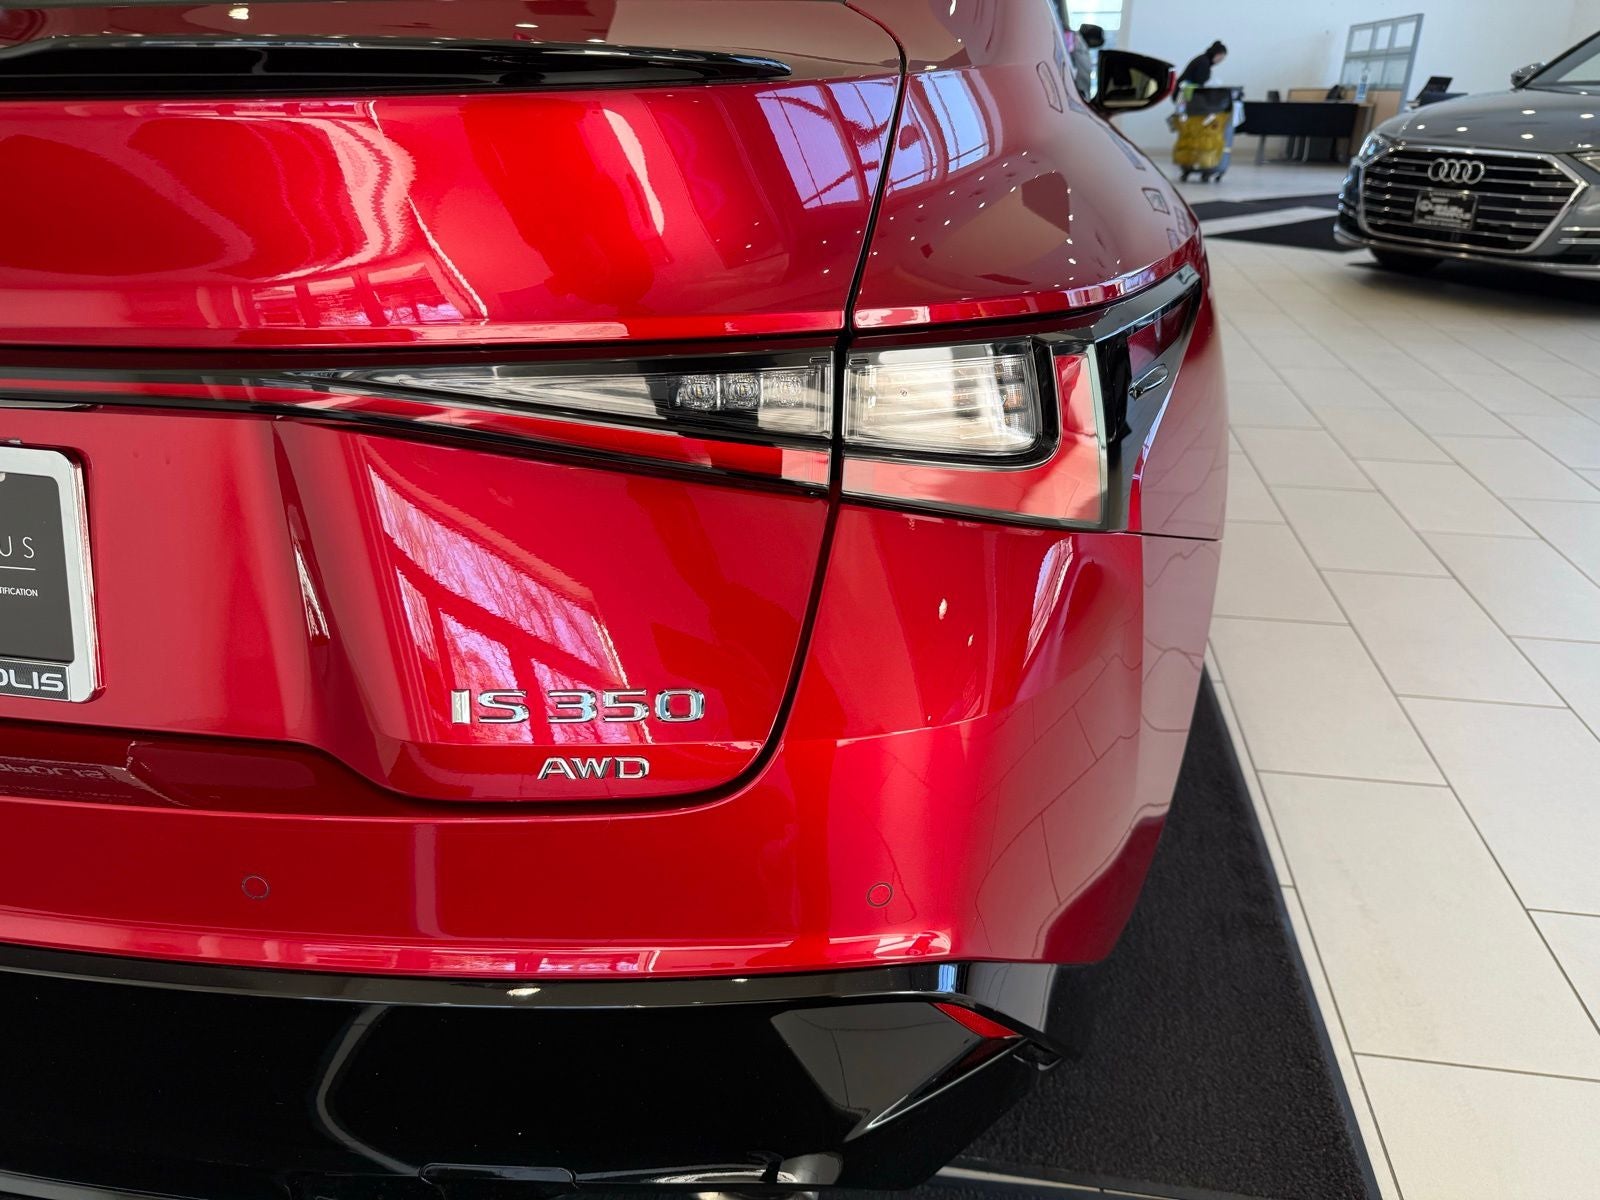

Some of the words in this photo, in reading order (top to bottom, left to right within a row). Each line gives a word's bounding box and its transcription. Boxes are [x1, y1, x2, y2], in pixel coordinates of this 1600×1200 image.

[450, 688, 530, 725] IS
[546, 688, 706, 724] 350
[536, 755, 650, 780] AWD
